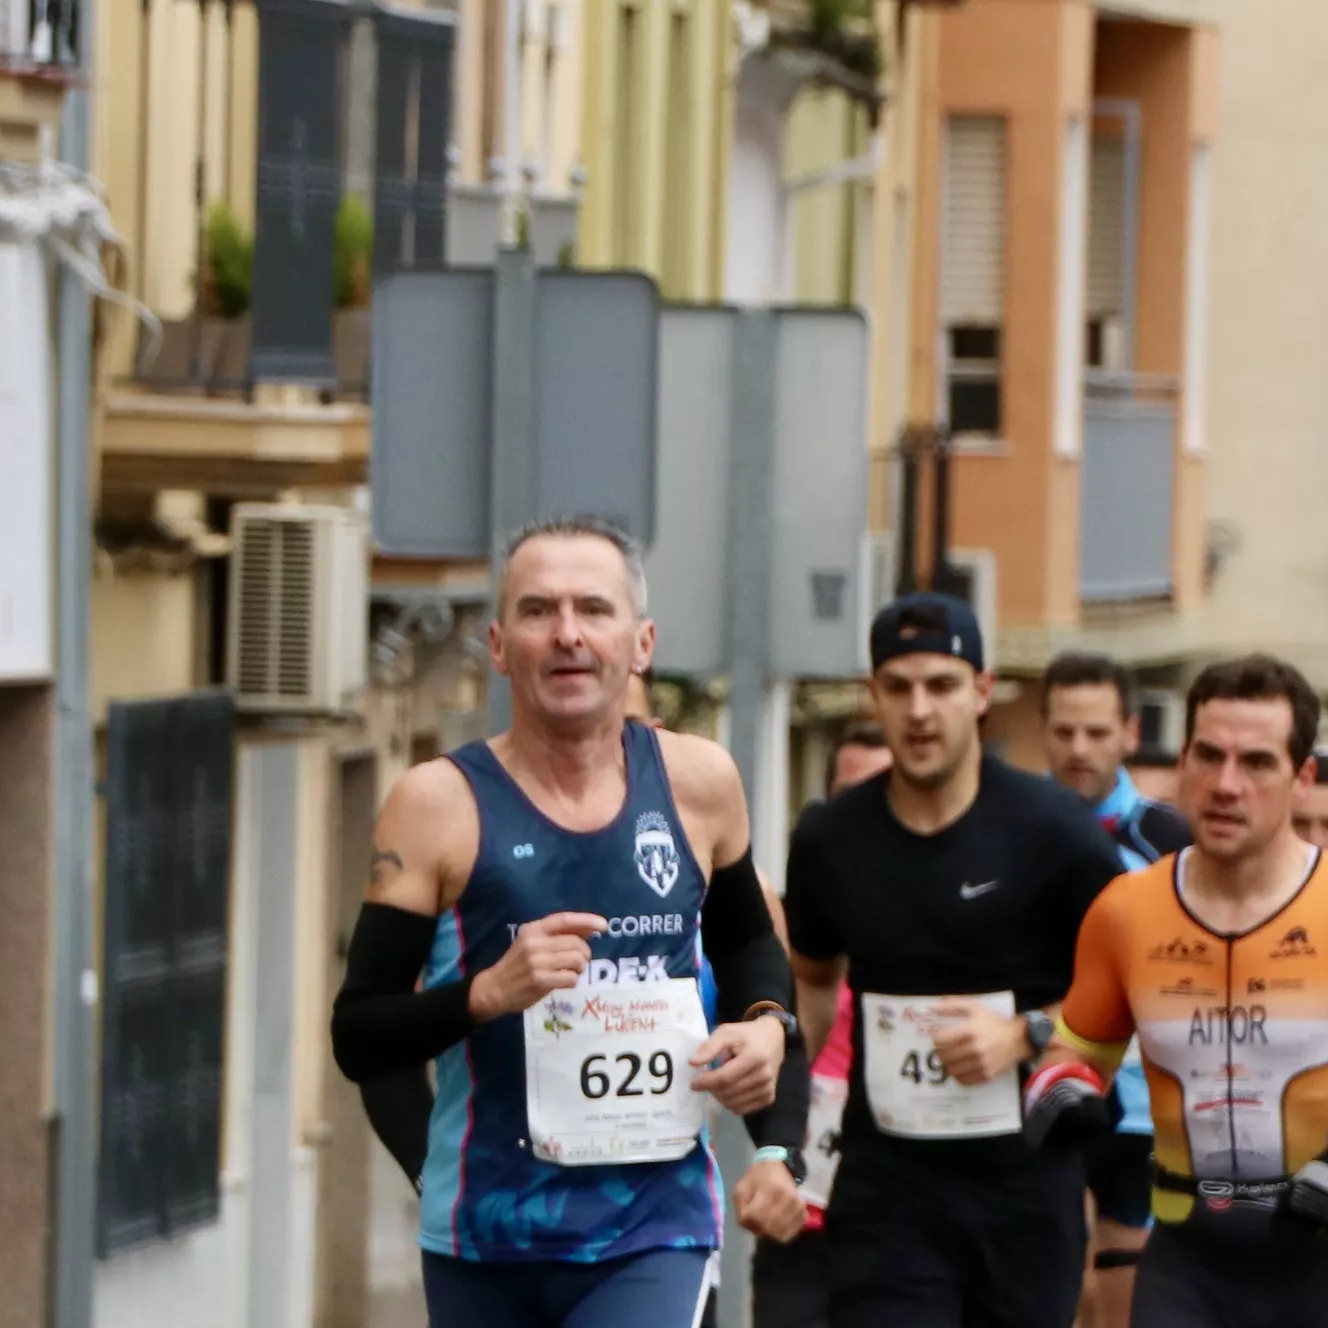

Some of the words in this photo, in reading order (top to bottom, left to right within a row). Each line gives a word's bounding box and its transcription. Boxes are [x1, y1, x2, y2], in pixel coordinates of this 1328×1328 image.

[608, 913, 683, 938] CORRER
[1188, 1004, 1269, 1045] AITOR
[579, 1049, 674, 1099] 629
[899, 1049, 950, 1086] 49
